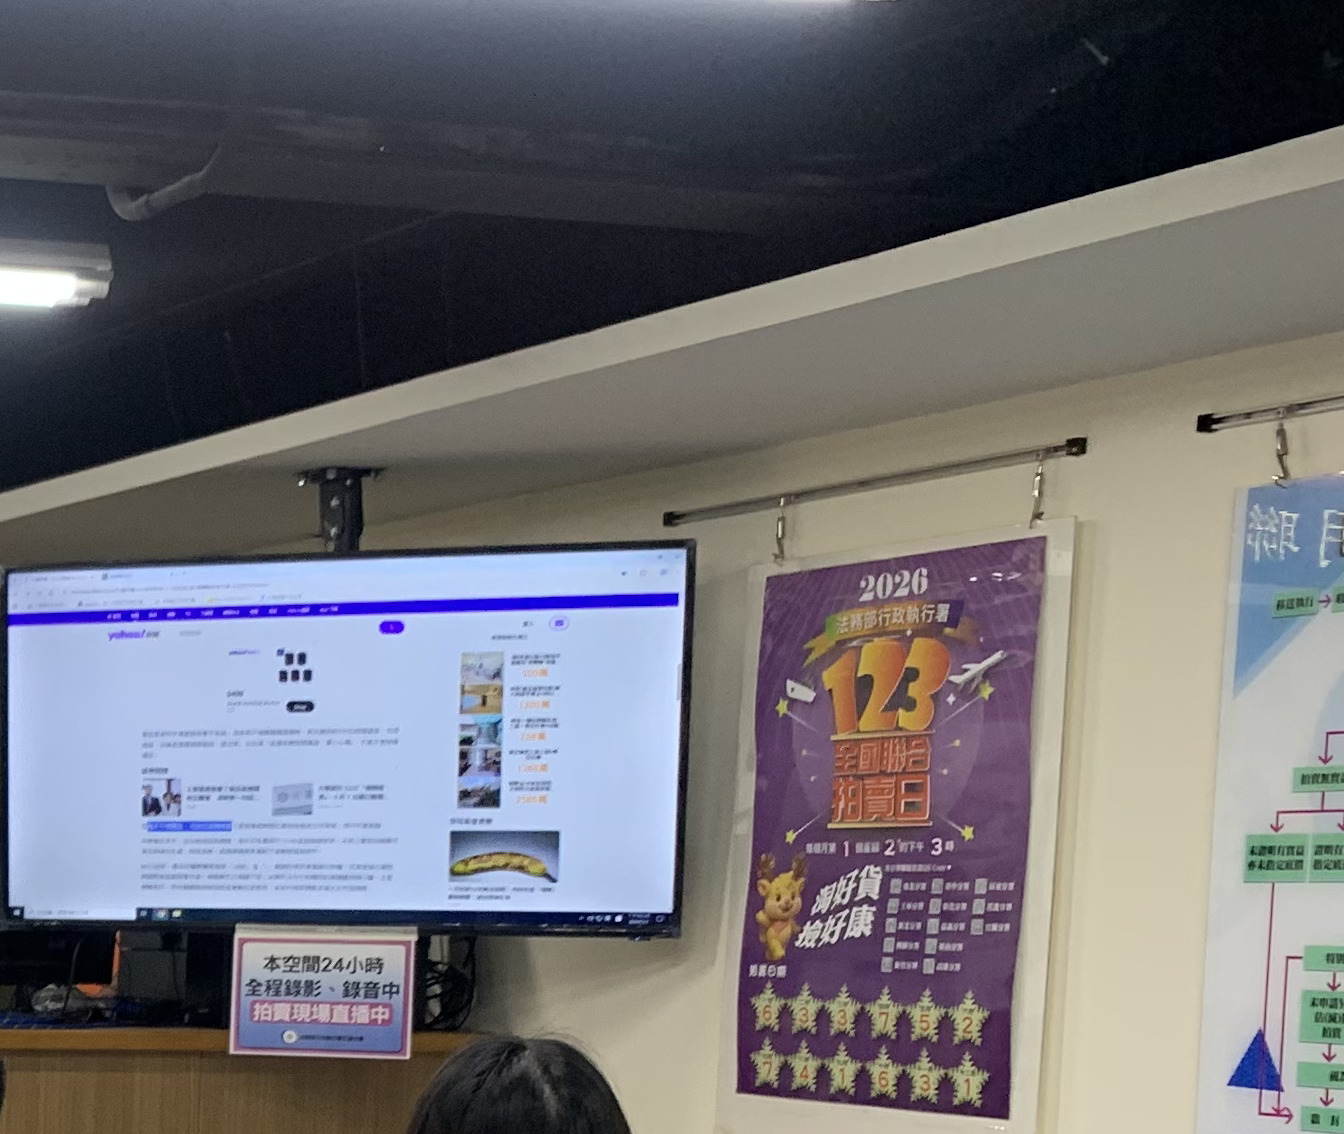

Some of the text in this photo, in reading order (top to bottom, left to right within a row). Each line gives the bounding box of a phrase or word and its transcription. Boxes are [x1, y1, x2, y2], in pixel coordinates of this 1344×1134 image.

[859, 567, 928, 602] 2026
[836, 603, 951, 634] 法務部行政執行署
[822, 637, 951, 735] 123
[831, 773, 931, 823] 拍賣日
[843, 840, 850, 857] 1
[883, 838, 896, 857] 2
[930, 837, 942, 856] 3
[263, 954, 385, 975] 本空間24小時
[244, 978, 401, 999] 全程錄影、錄音中
[252, 1002, 390, 1024] 拍賣現場直播中
[762, 1004, 772, 1023] 6
[878, 1011, 889, 1030] 7
[919, 1014, 930, 1032] 5
[962, 1016, 973, 1035] 2
[799, 1064, 810, 1081] 4
[878, 1070, 889, 1089] 6
[919, 1074, 930, 1093] 3
[964, 1078, 971, 1097] 1
